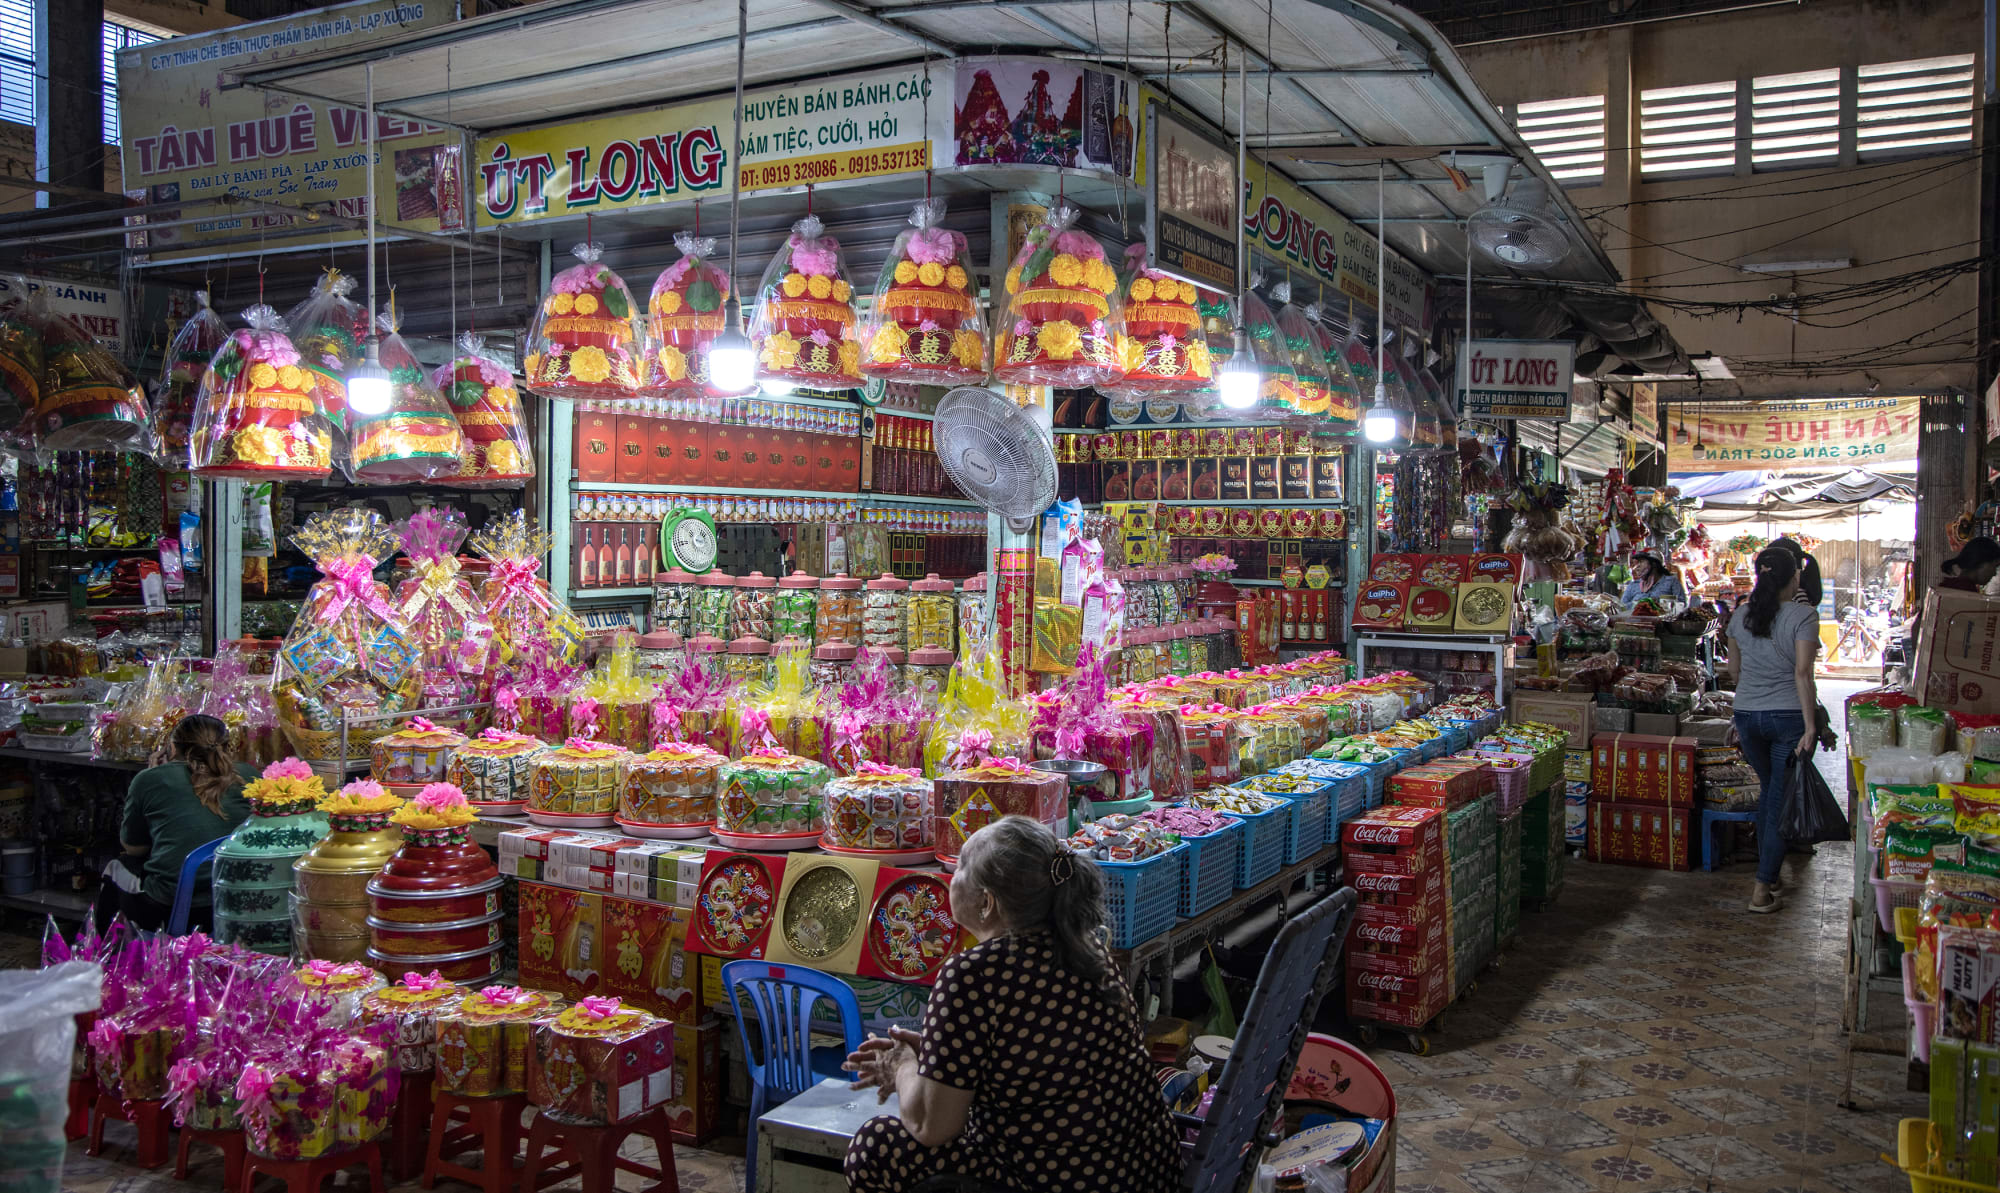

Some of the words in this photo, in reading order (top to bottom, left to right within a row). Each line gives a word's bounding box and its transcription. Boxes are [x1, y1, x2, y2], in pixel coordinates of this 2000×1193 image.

[174, 50, 199, 66] TNHH
[304, 22, 332, 41] BÁNH
[805, 88, 837, 114] BÁN
[896, 75, 932, 102] CÁC
[133, 124, 217, 176] TÂN
[228, 102, 317, 164] HUÊ
[234, 168, 267, 184] BÁNH
[481, 142, 555, 219] ÚT
[566, 124, 726, 207] LONG
[762, 165, 790, 184] 0919
[794, 159, 838, 181] 328086
[1472, 350, 1498, 384] ÚT
[1502, 357, 1559, 386] LONG
[1463, 391, 1490, 404] CUYÊN
[1491, 391, 1508, 404] BÁN
[1508, 391, 1529, 405] BÁNH
[1953, 951, 1963, 991] HEAVY
[1964, 958, 1973, 990] DUTY
